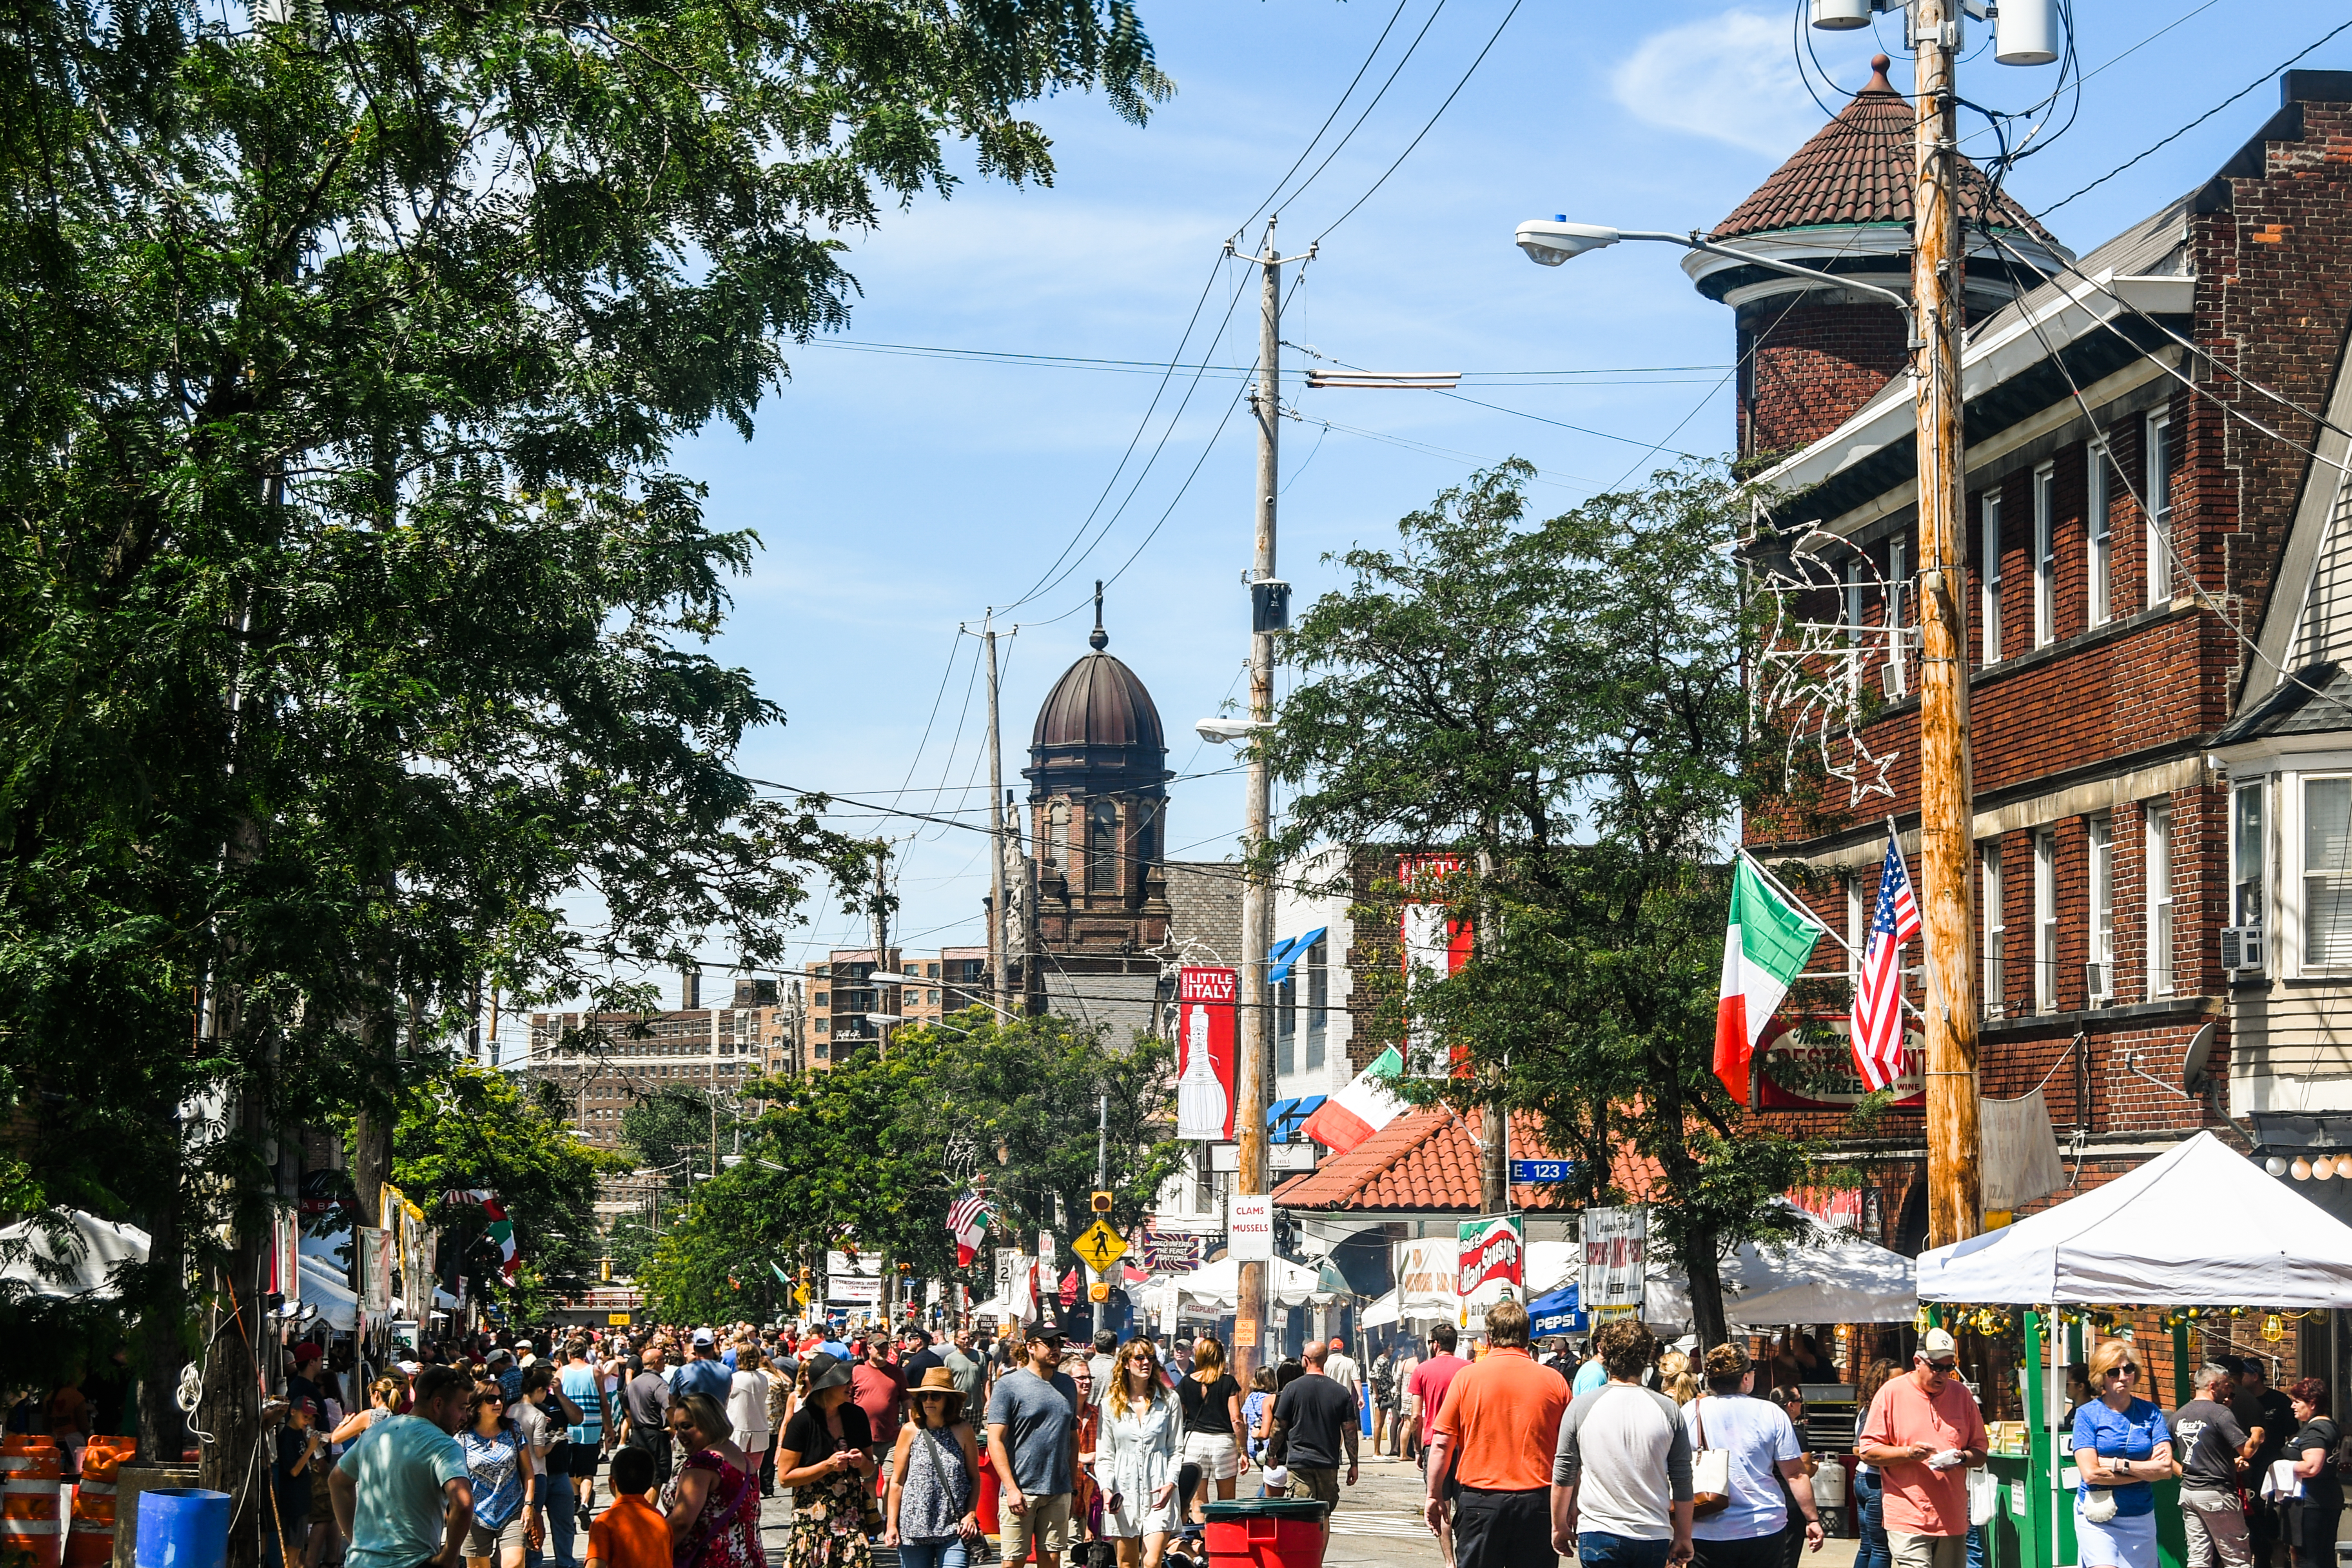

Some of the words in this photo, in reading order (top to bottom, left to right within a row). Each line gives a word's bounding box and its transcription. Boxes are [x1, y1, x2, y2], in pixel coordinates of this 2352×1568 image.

[1189, 973, 1233, 984] LITTLE
[1188, 984, 1232, 999] ITALY
[1514, 1164, 1527, 1177] E.
[1533, 1164, 1560, 1178] 123
[1232, 1224, 1269, 1232] MUSSELS
[1482, 1238, 1517, 1277] Sausage
[1187, 1305, 1219, 1315] EGGPLANT
[1535, 1313, 1576, 1332] PEPSI
